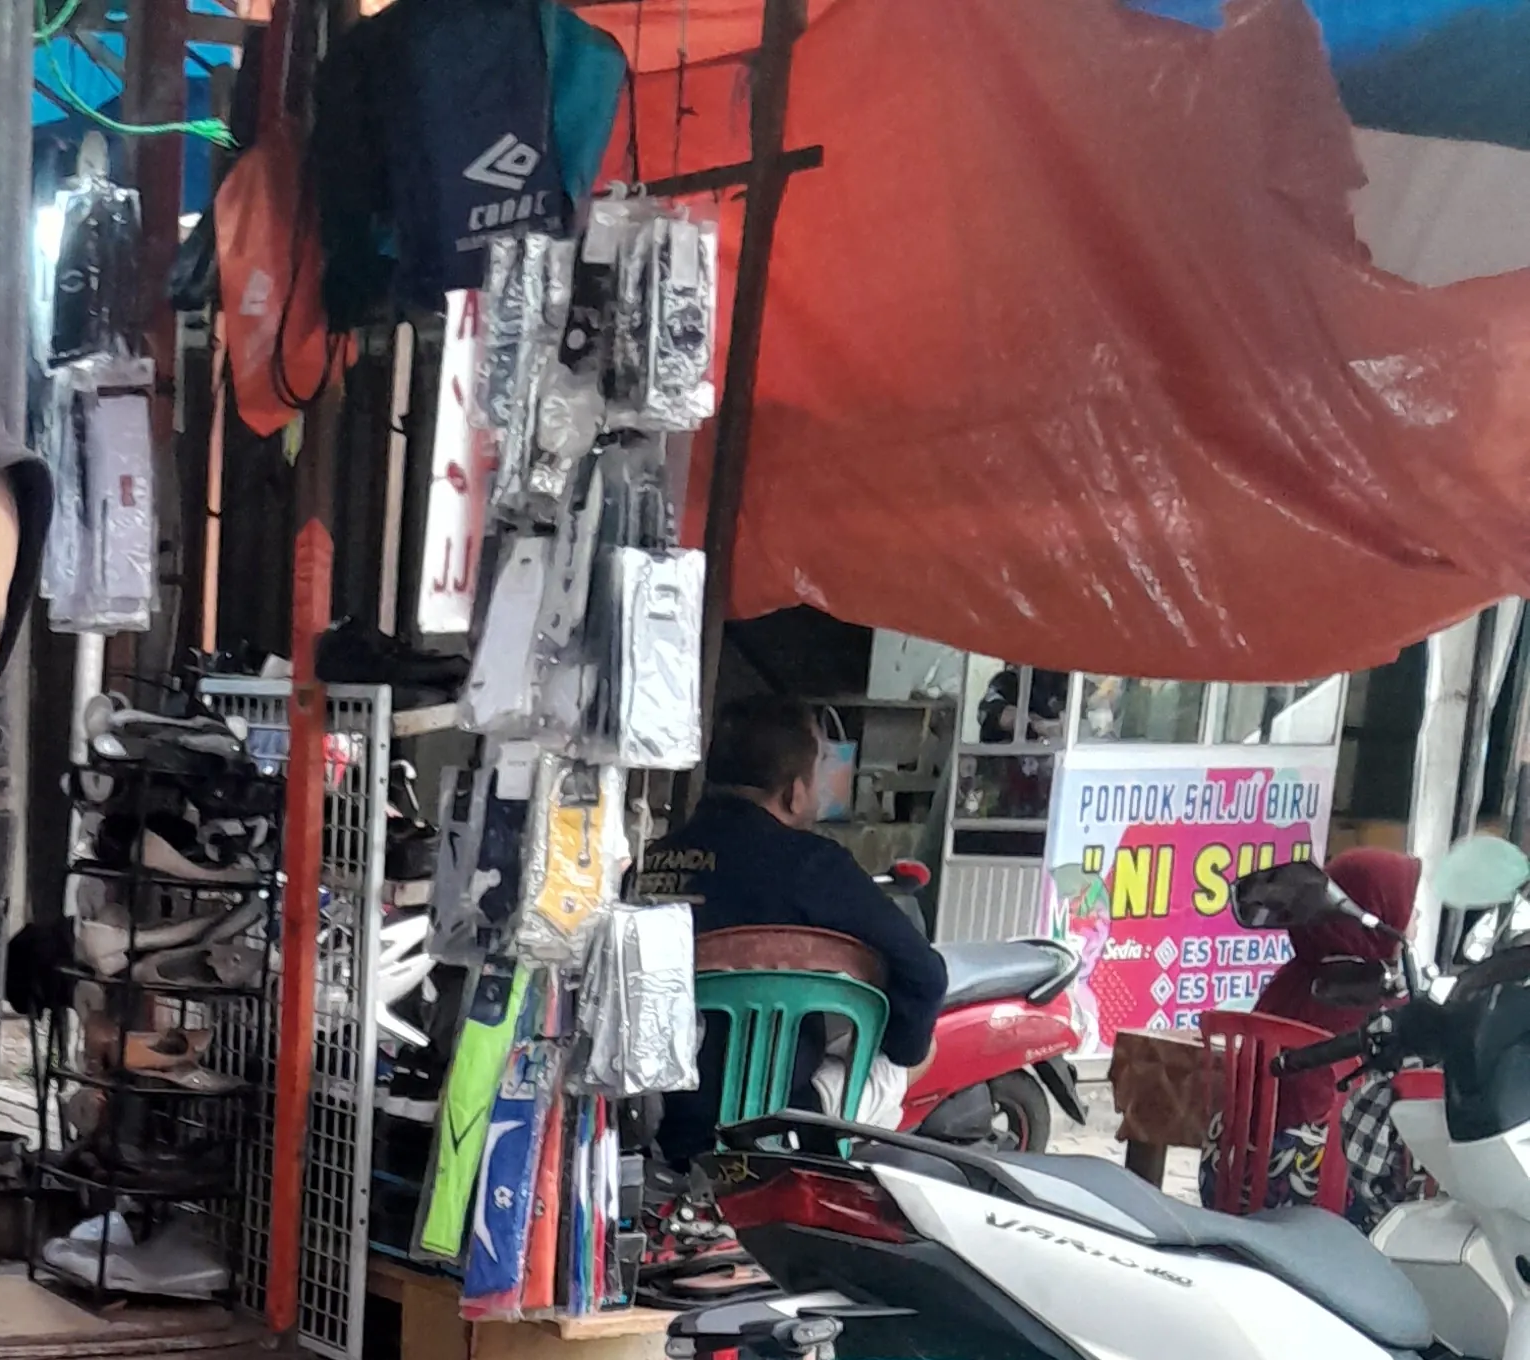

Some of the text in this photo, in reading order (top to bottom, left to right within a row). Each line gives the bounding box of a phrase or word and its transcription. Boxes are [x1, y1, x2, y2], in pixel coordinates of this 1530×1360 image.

[1079, 783, 1321, 823] PONDOK SALJU BIRU
[1182, 940, 1210, 964] ES
[1178, 976, 1205, 1000] ES
